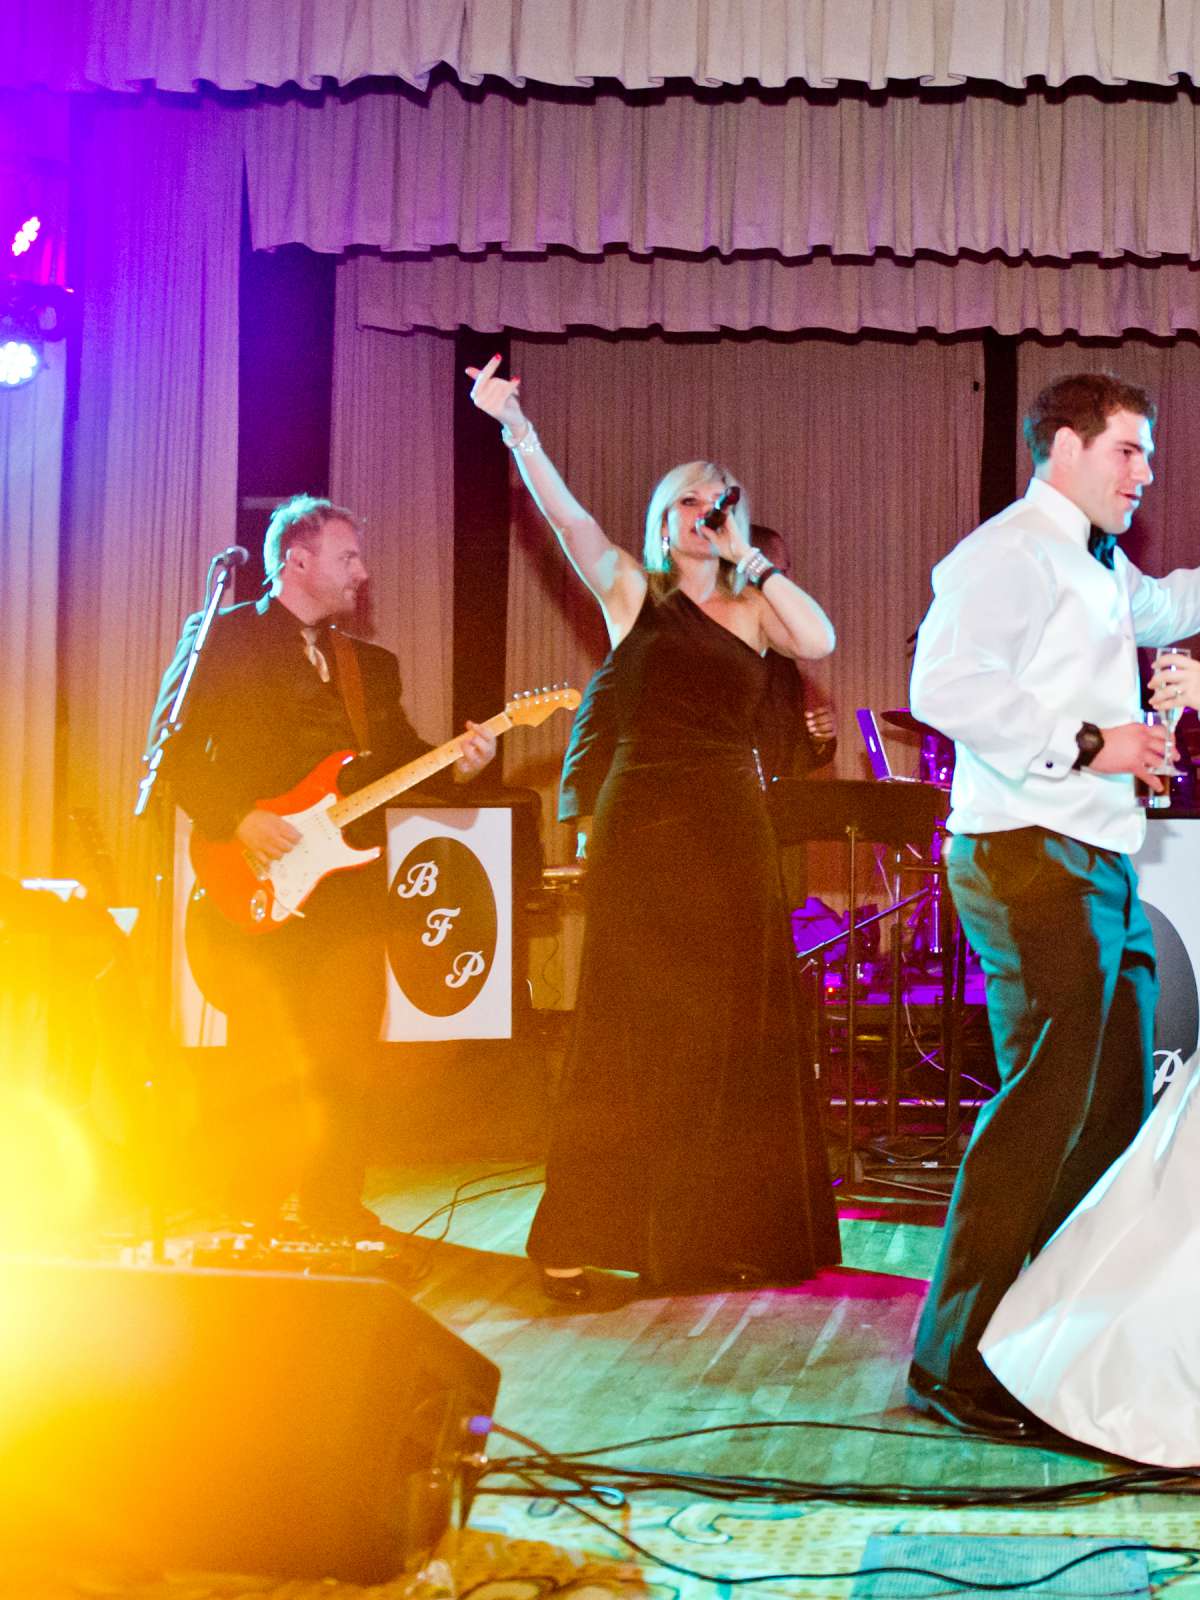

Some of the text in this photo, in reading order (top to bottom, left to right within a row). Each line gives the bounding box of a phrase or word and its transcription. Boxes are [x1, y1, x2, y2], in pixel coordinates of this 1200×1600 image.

[397, 860, 439, 898] B
[421, 907, 461, 947] F
[445, 950, 485, 988] P
